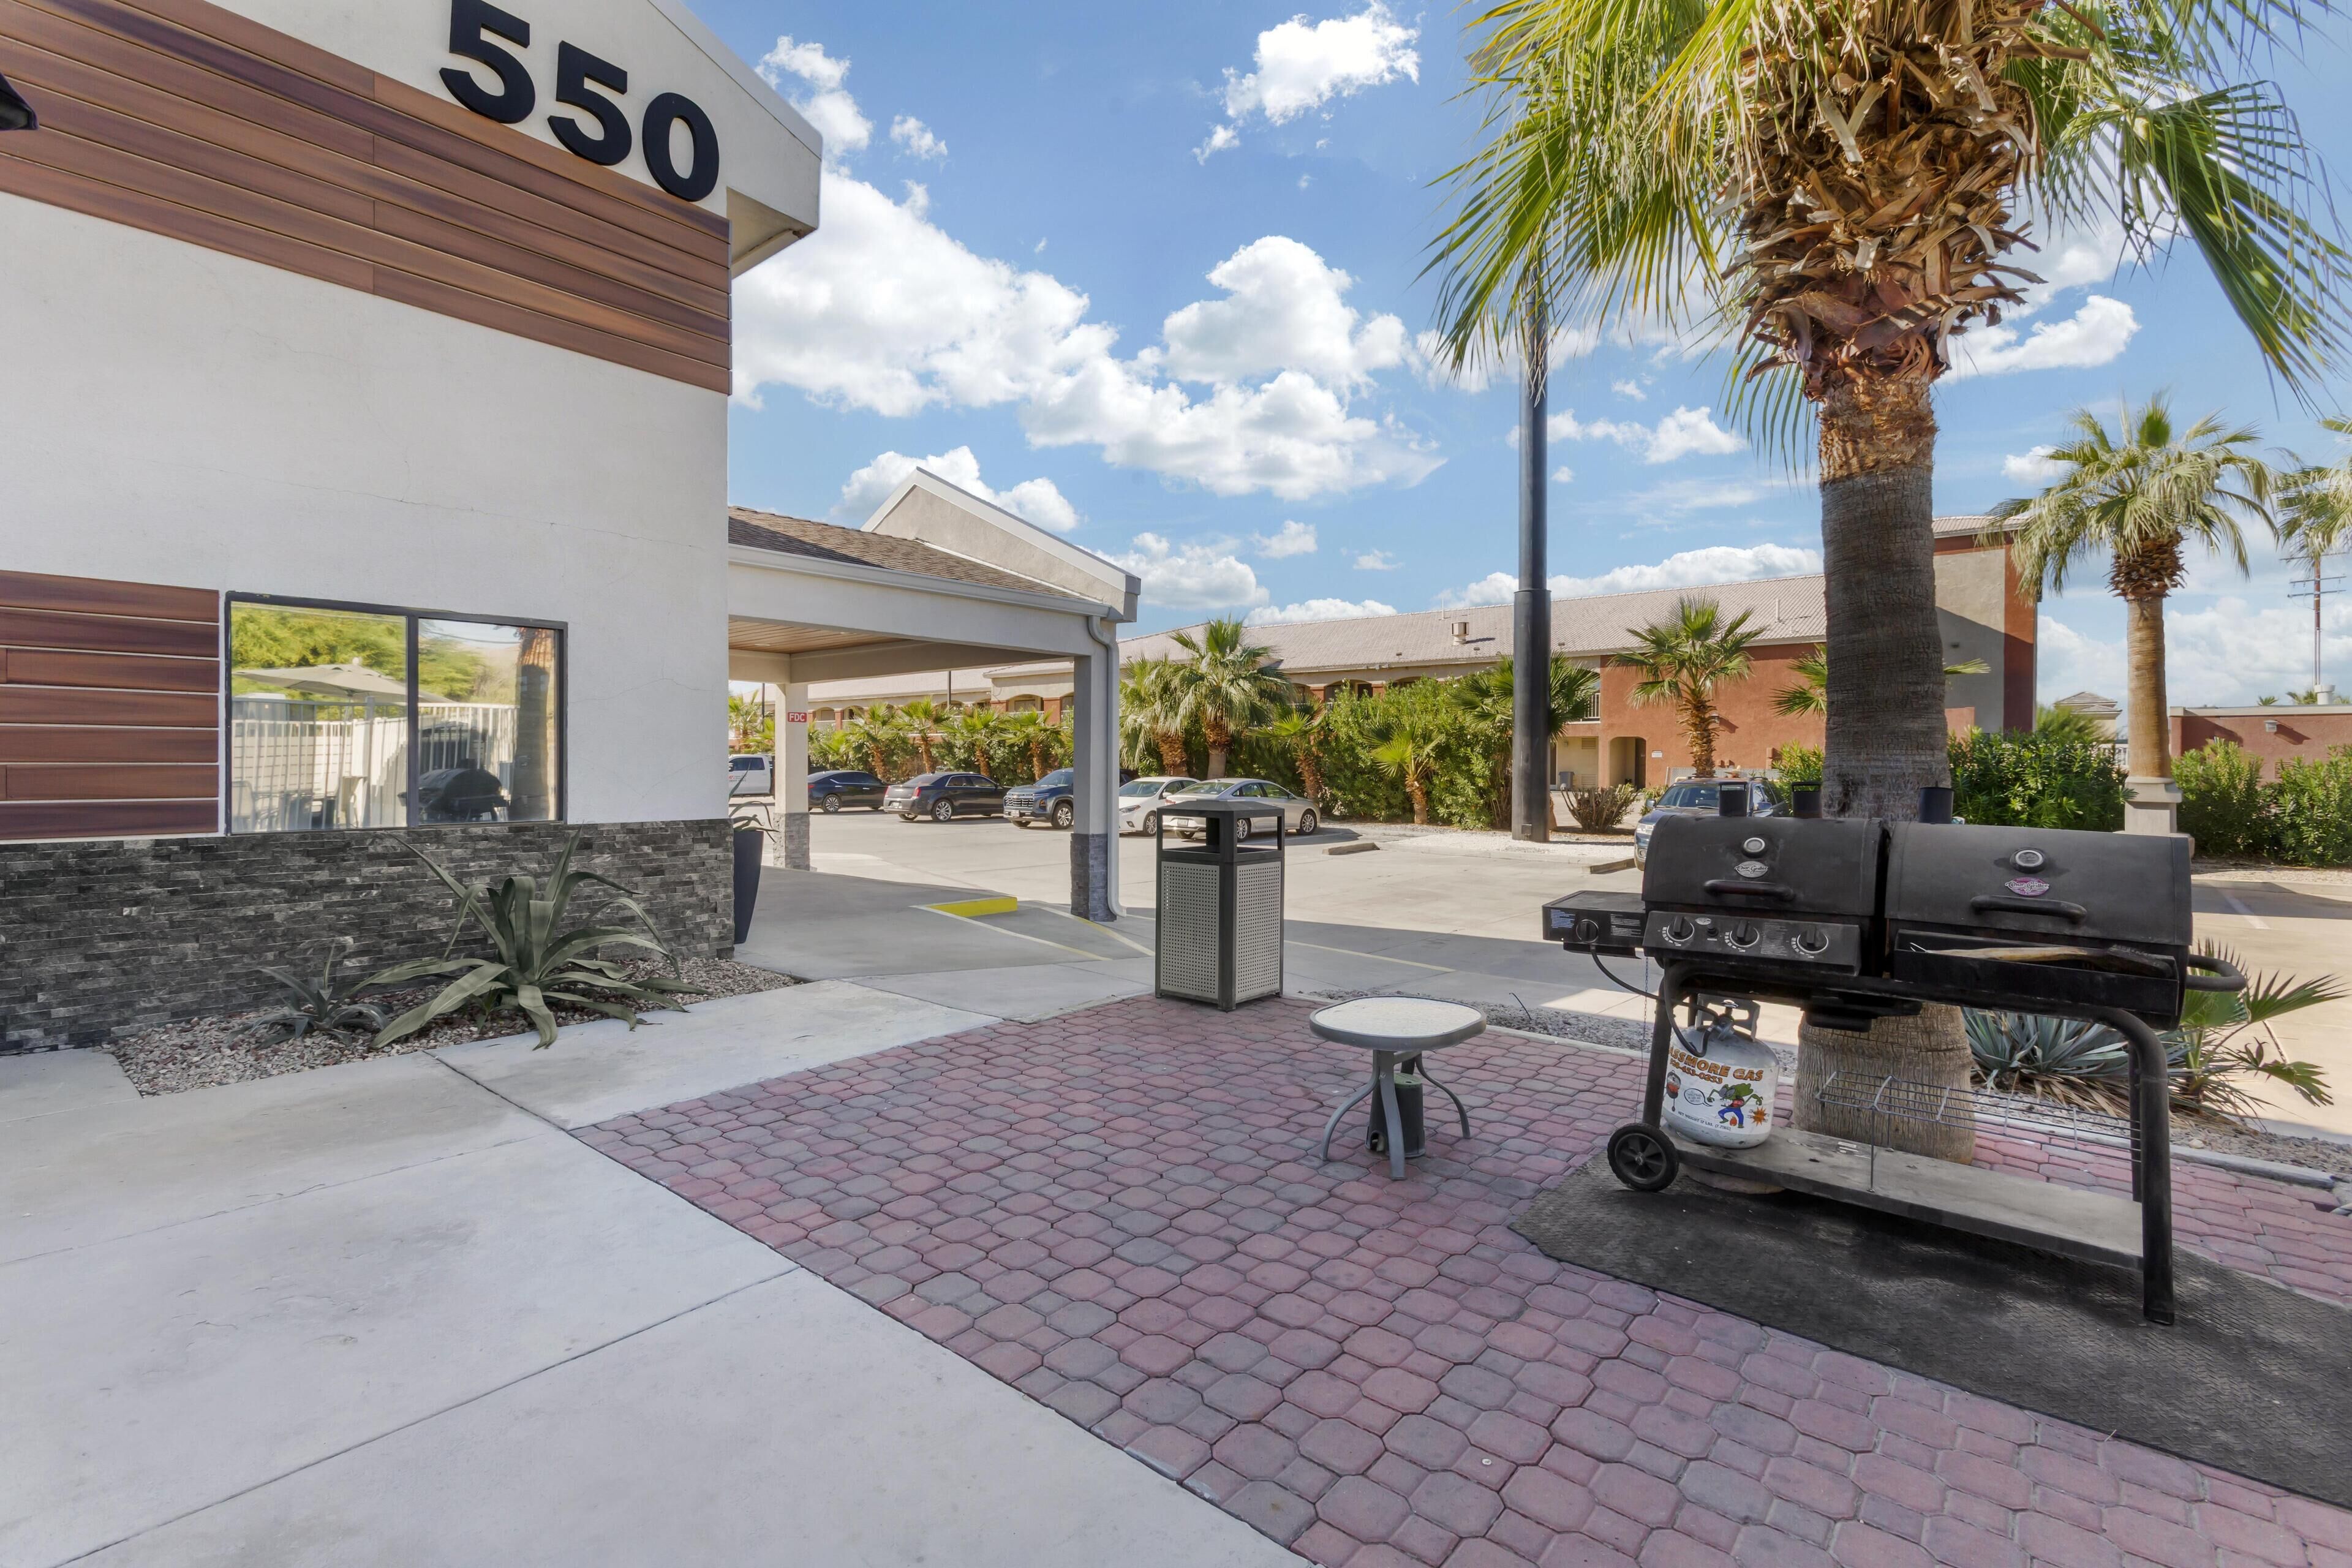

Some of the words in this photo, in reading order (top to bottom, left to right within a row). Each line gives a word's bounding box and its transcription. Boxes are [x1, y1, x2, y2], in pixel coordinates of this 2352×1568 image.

[439, 0, 719, 202] 550
[789, 712, 805, 722] FDC
[1733, 1068, 1764, 1081] GAS
